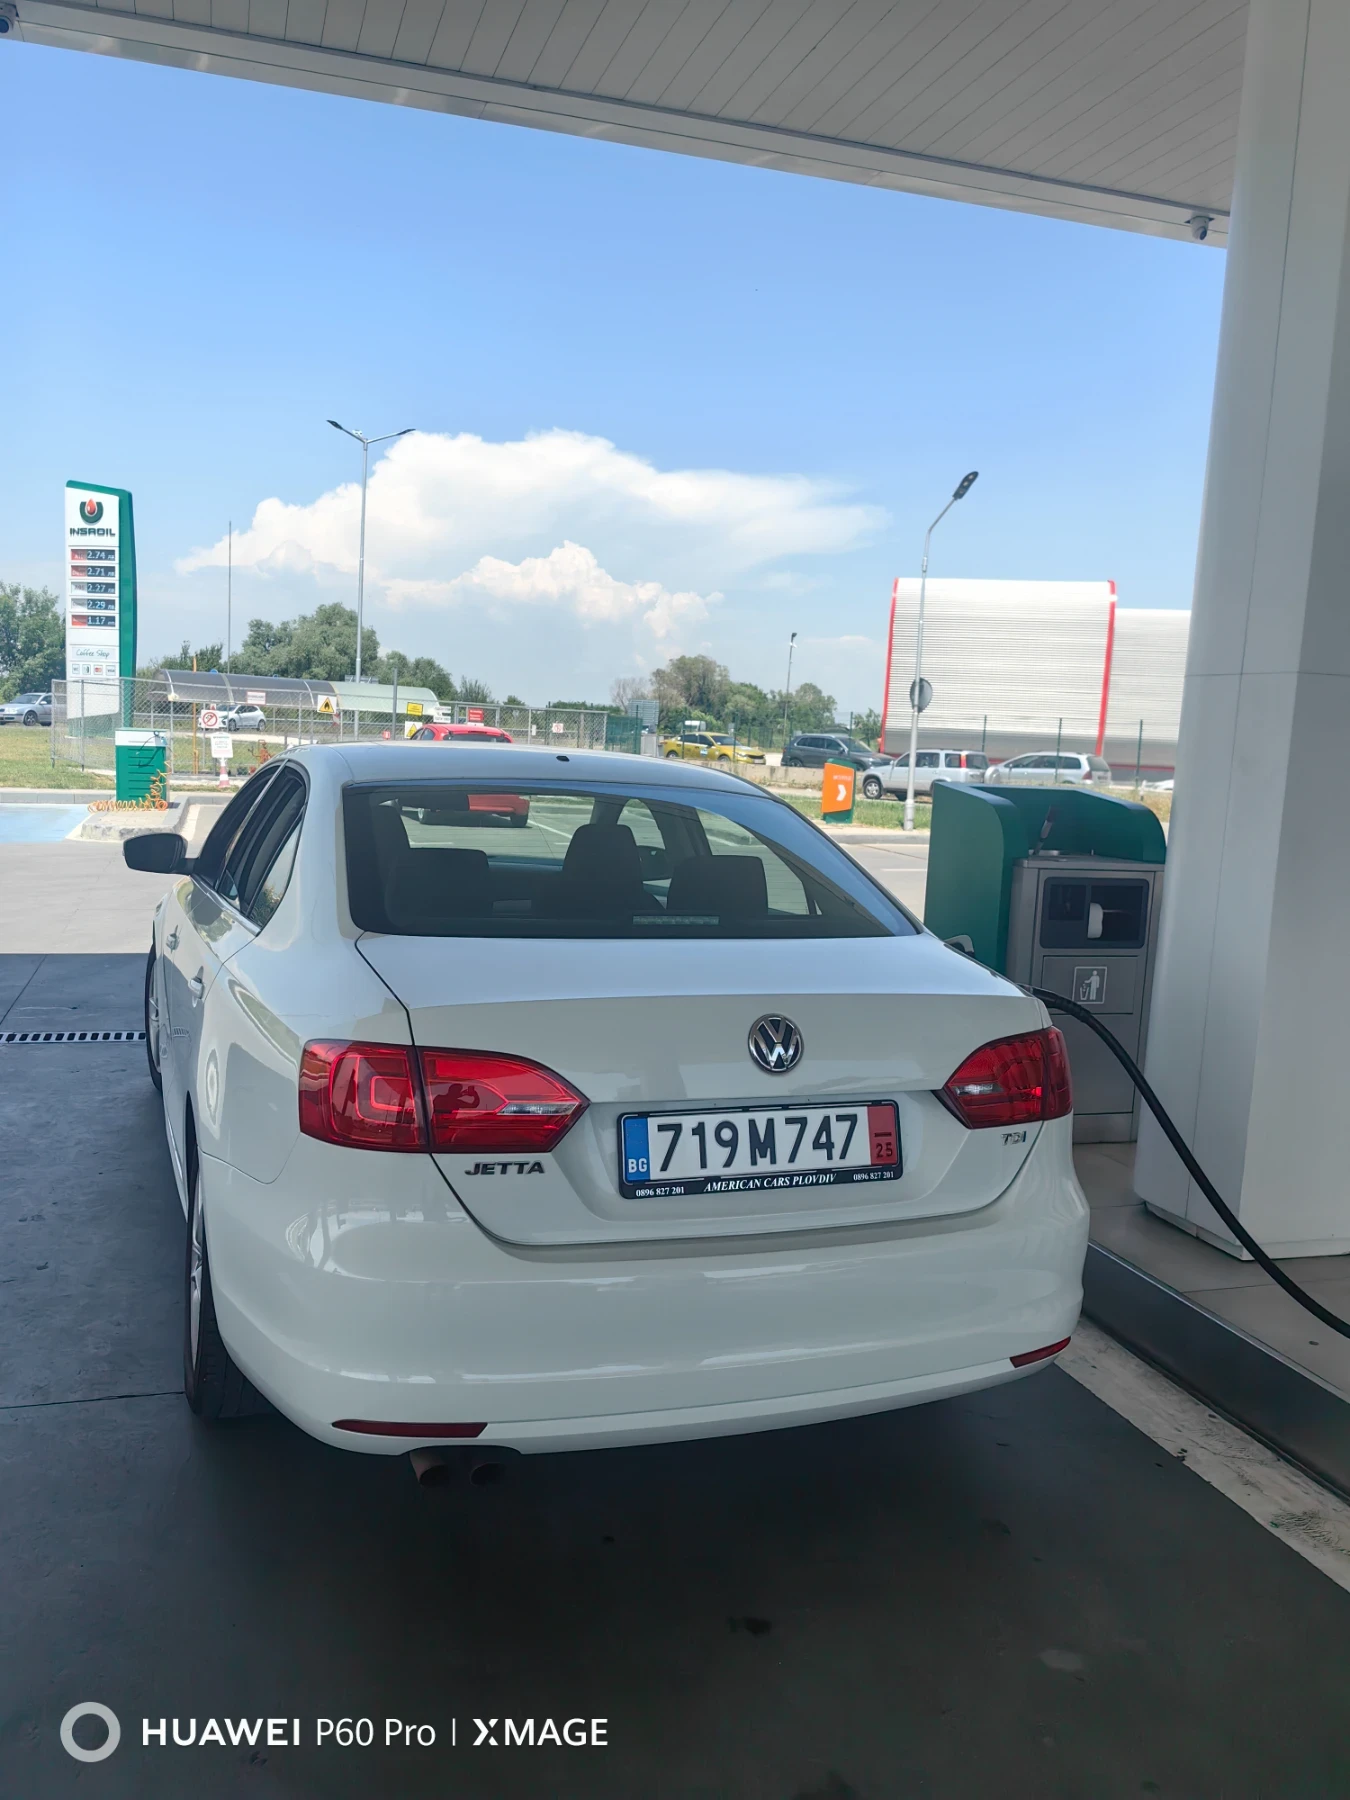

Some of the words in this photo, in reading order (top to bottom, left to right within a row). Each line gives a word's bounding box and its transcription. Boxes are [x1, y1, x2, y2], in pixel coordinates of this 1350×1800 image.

[69, 527, 115, 537] INSAOIL
[87, 550, 106, 560] 2.74
[87, 567, 106, 576] 2.71
[87, 584, 106, 593] 2.27
[87, 600, 106, 609] 2.29
[87, 616, 106, 625] 1.17
[76, 649, 94, 657] Coffee
[96, 649, 110, 660] Shop
[657, 1113, 858, 1173] 719M747
[1001, 1131, 1027, 1146] TDI
[875, 1142, 893, 1158] 25
[464, 1160, 545, 1175] JETTA
[628, 1158, 648, 1174] BG
[853, 1173, 869, 1181] 0896
[869, 1172, 881, 1180] 827
[882, 1171, 894, 1179] 201
[703, 1179, 762, 1192] AMERICAN
[763, 1176, 790, 1188] CARS
[792, 1173, 837, 1186] PLOVDIV
[635, 1187, 654, 1197] 0896
[656, 1187, 670, 1196] 827
[671, 1186, 685, 1195] 201
